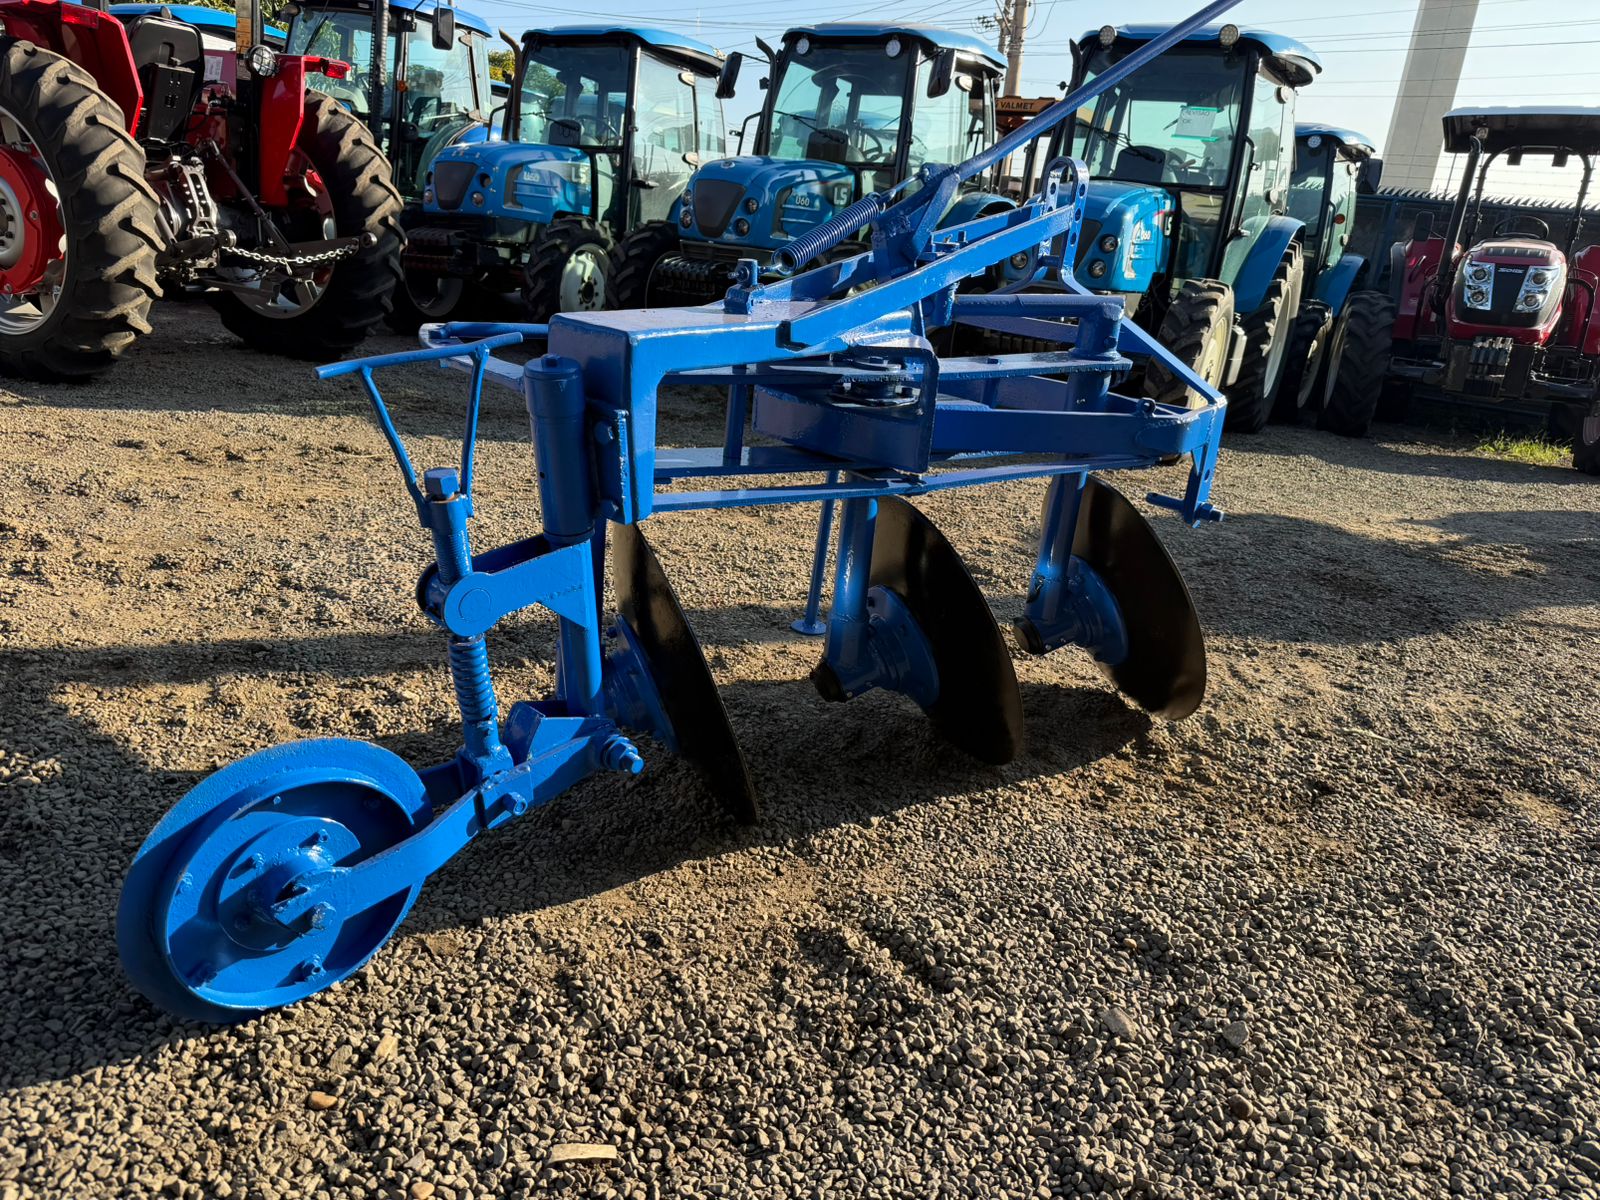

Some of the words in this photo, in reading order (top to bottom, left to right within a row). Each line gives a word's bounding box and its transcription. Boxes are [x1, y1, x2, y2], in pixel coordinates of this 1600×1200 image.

[1000, 102, 1034, 110] VALMET
[571, 166, 588, 184] LS
[795, 195, 810, 206] U60
[833, 187, 848, 205] LS
